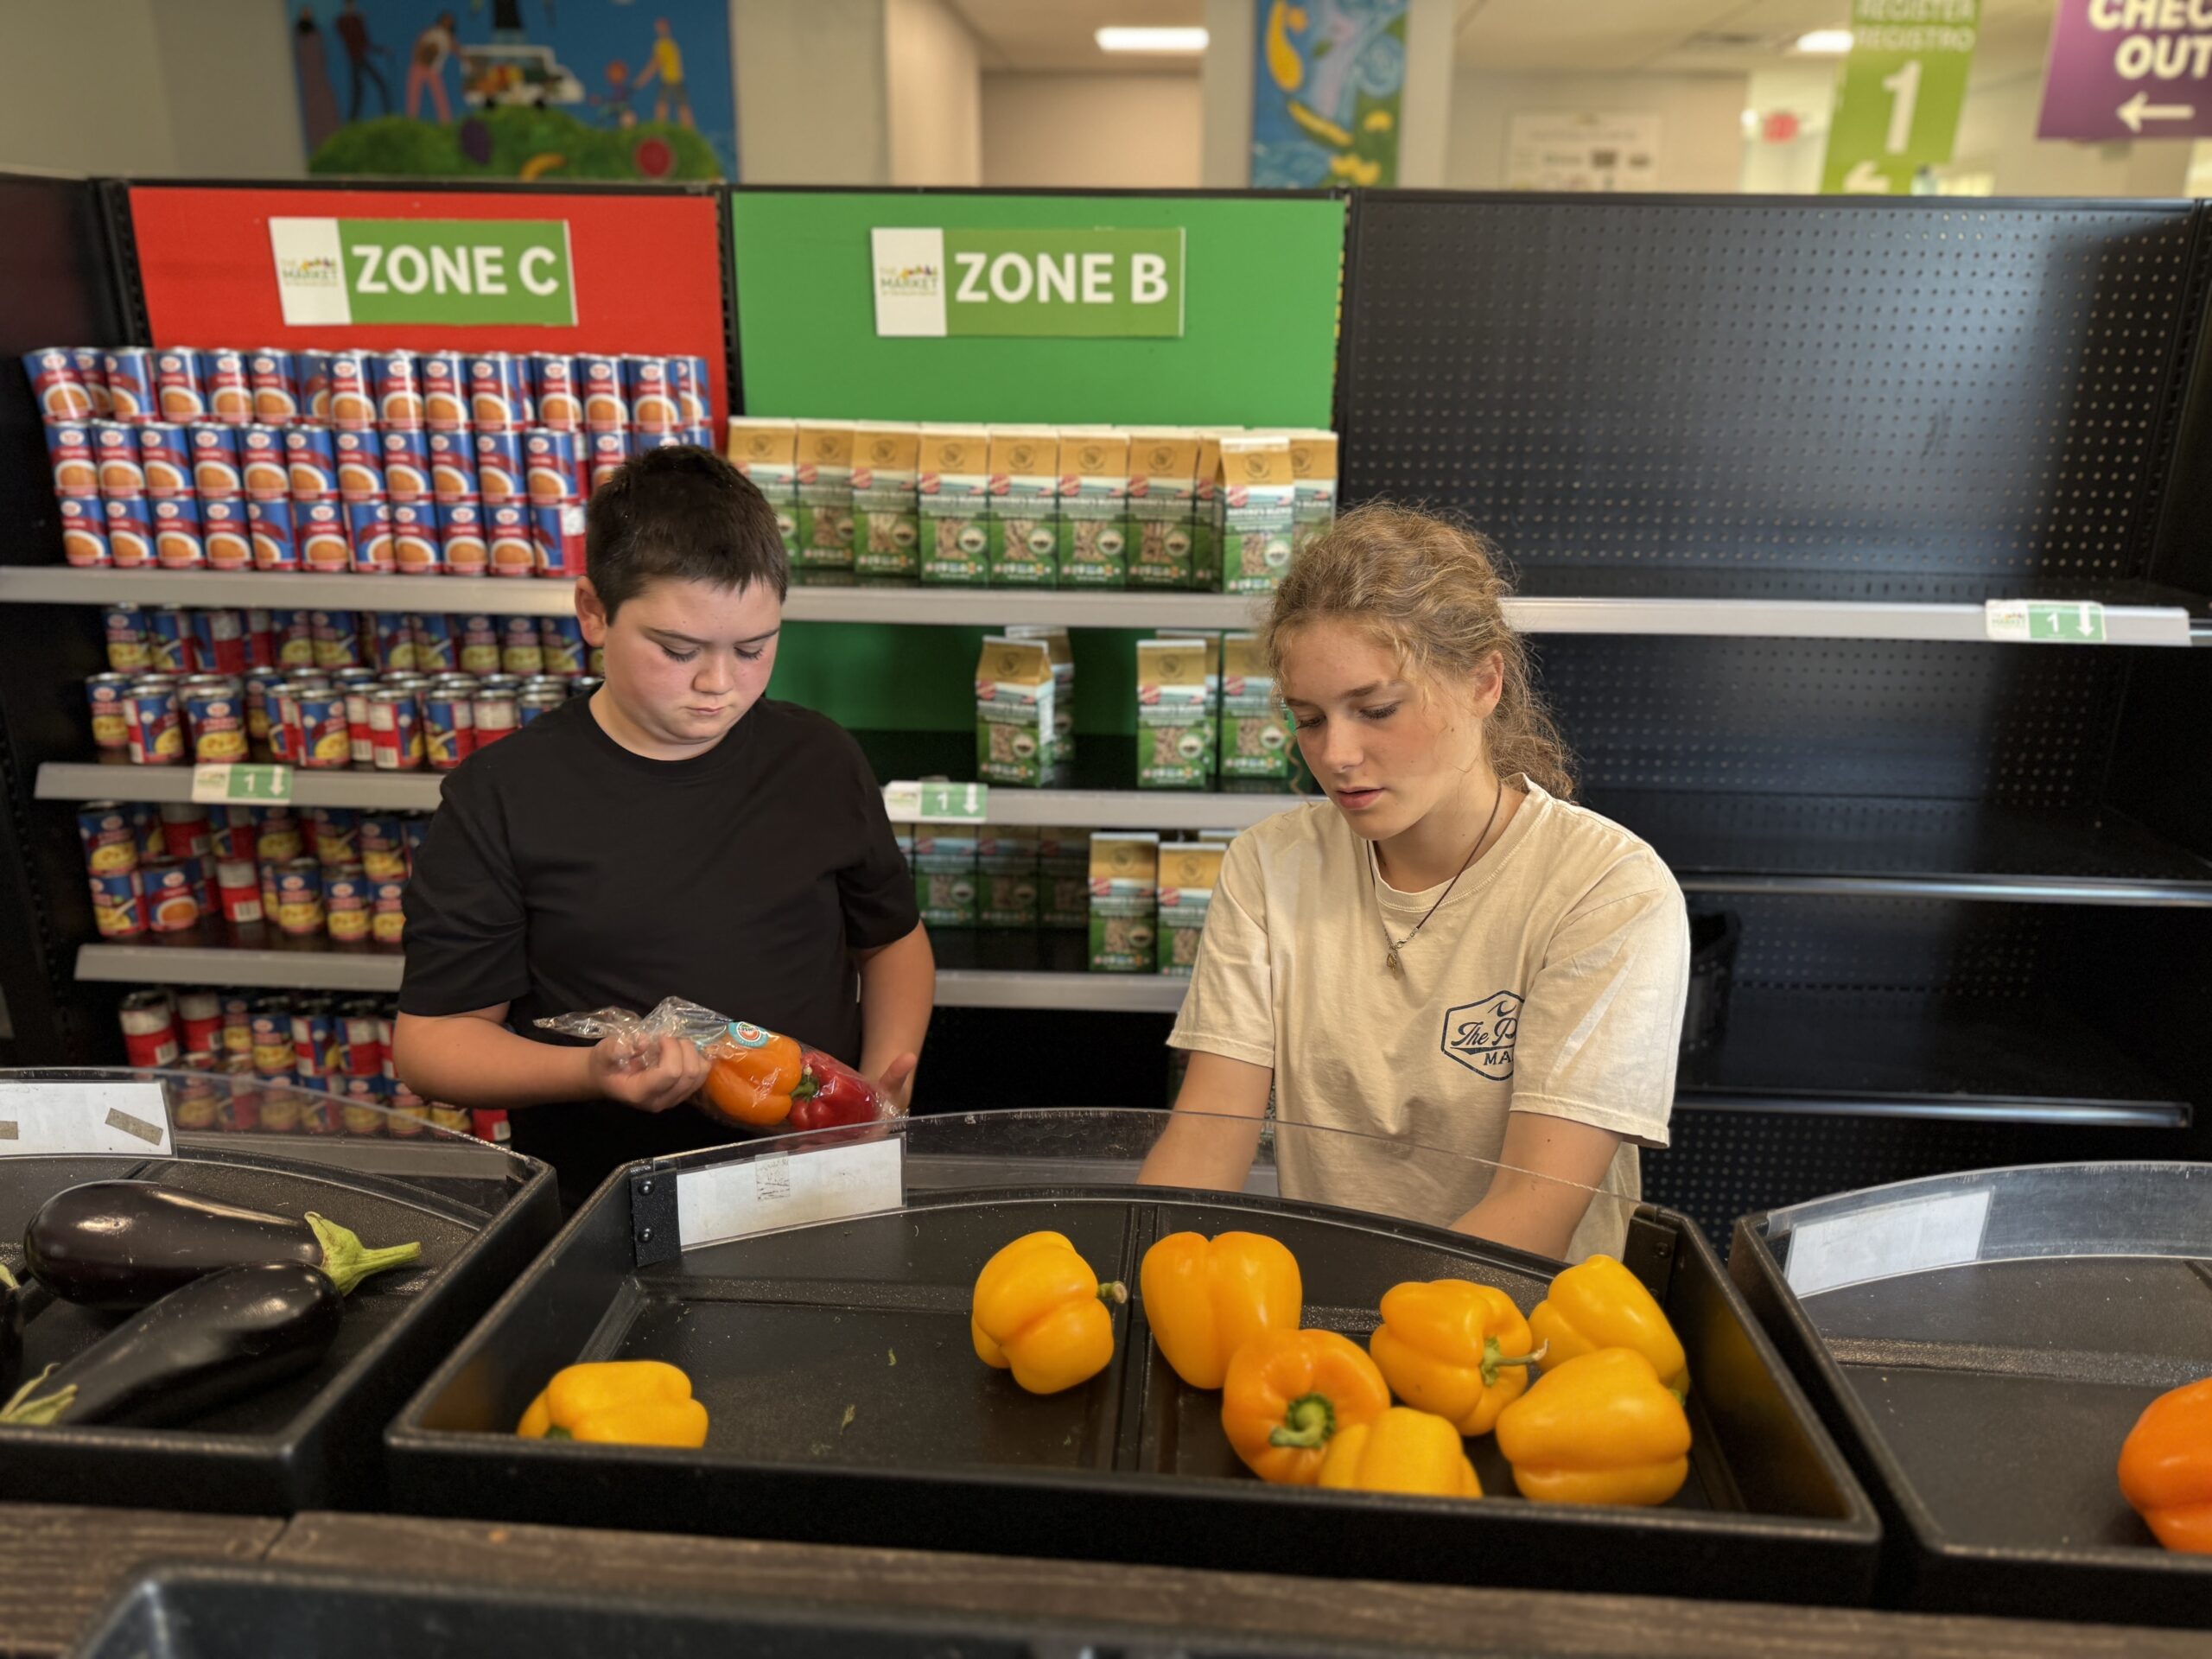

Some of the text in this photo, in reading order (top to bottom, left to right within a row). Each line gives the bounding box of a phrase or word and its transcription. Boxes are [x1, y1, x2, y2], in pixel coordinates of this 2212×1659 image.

[1857, 0, 1976, 22] REGISTER
[1856, 25, 1977, 52] REGISTRO
[2114, 34, 2212, 80] OUT
[1881, 60, 1923, 154] 1
[351, 245, 560, 297] ZONE C
[954, 251, 1169, 304] ZONE B
[2046, 611, 2060, 633] 1
[243, 772, 256, 792] 1
[936, 791, 949, 811] 1
[1451, 1021, 1490, 1046] The
[1483, 1051, 1514, 1066] MA
